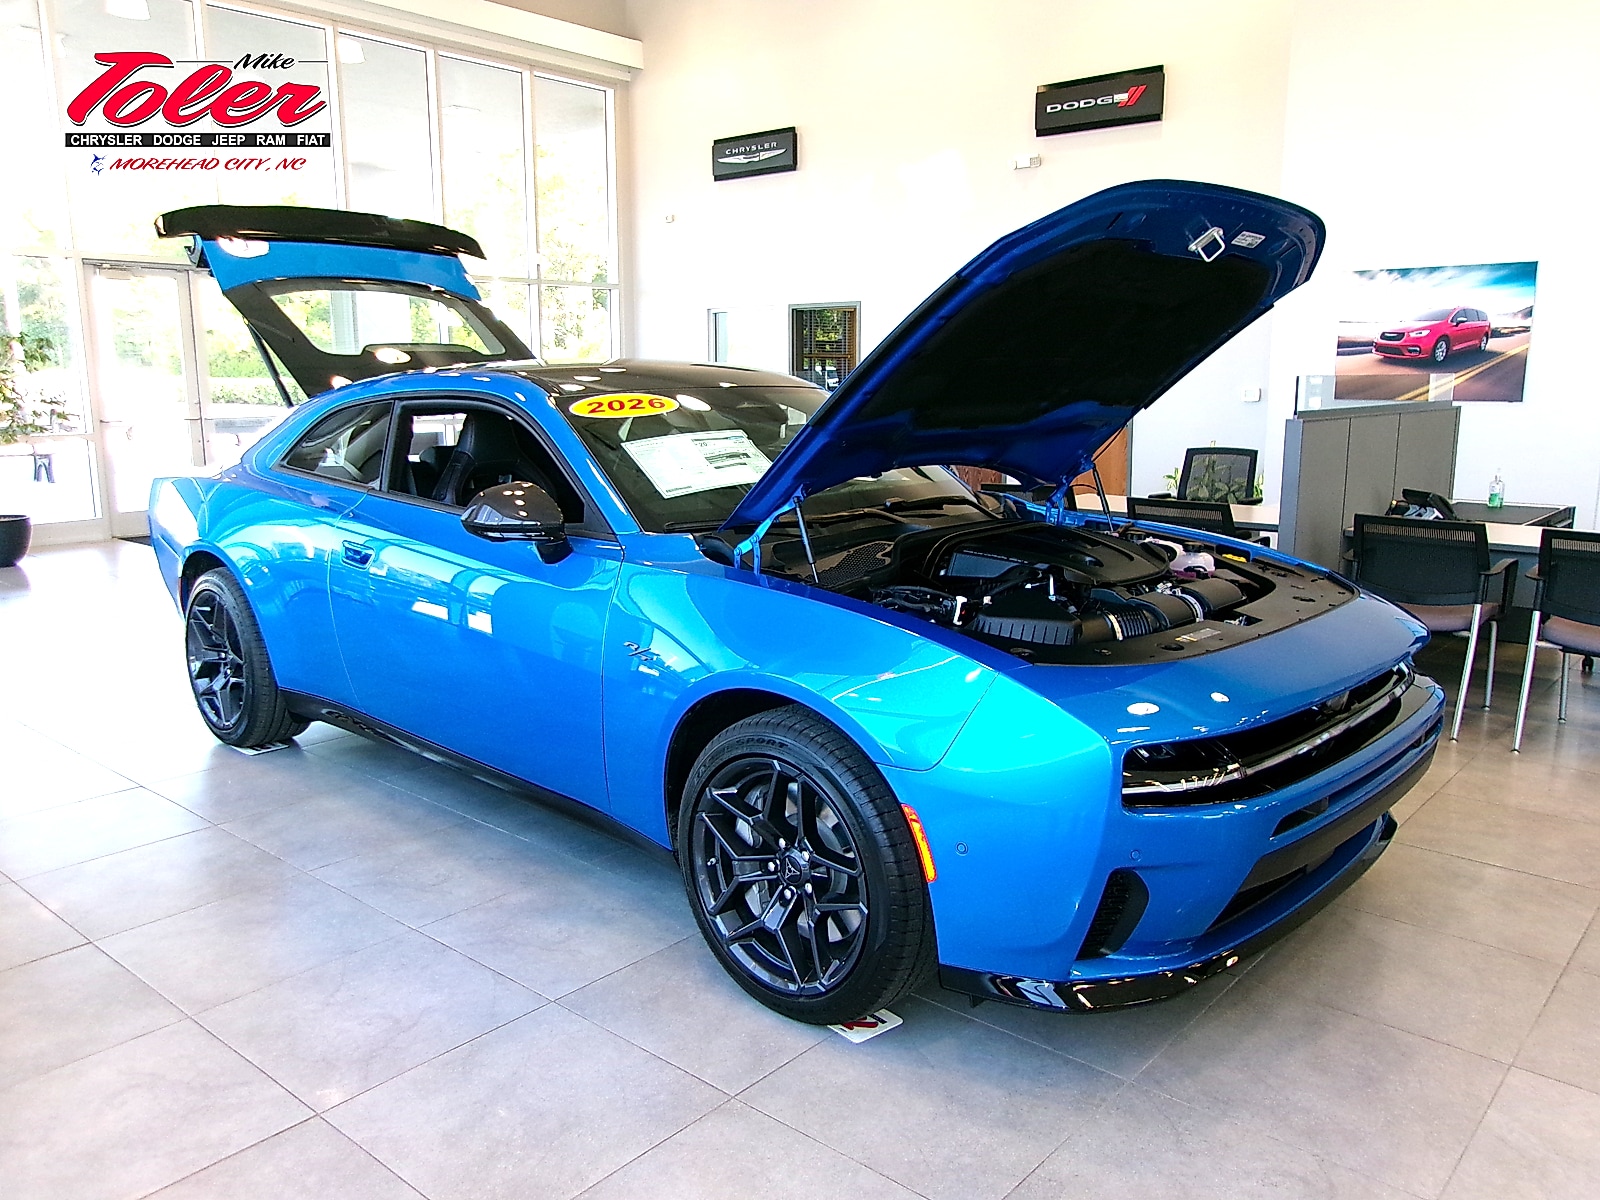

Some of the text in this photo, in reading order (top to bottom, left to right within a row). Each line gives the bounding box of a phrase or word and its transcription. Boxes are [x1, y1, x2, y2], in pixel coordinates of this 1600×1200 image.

[1046, 92, 1129, 113] DODGE
[725, 141, 778, 155] CHRYSLER
[586, 398, 666, 414] 2026
[736, 737, 789, 749] SPORT
